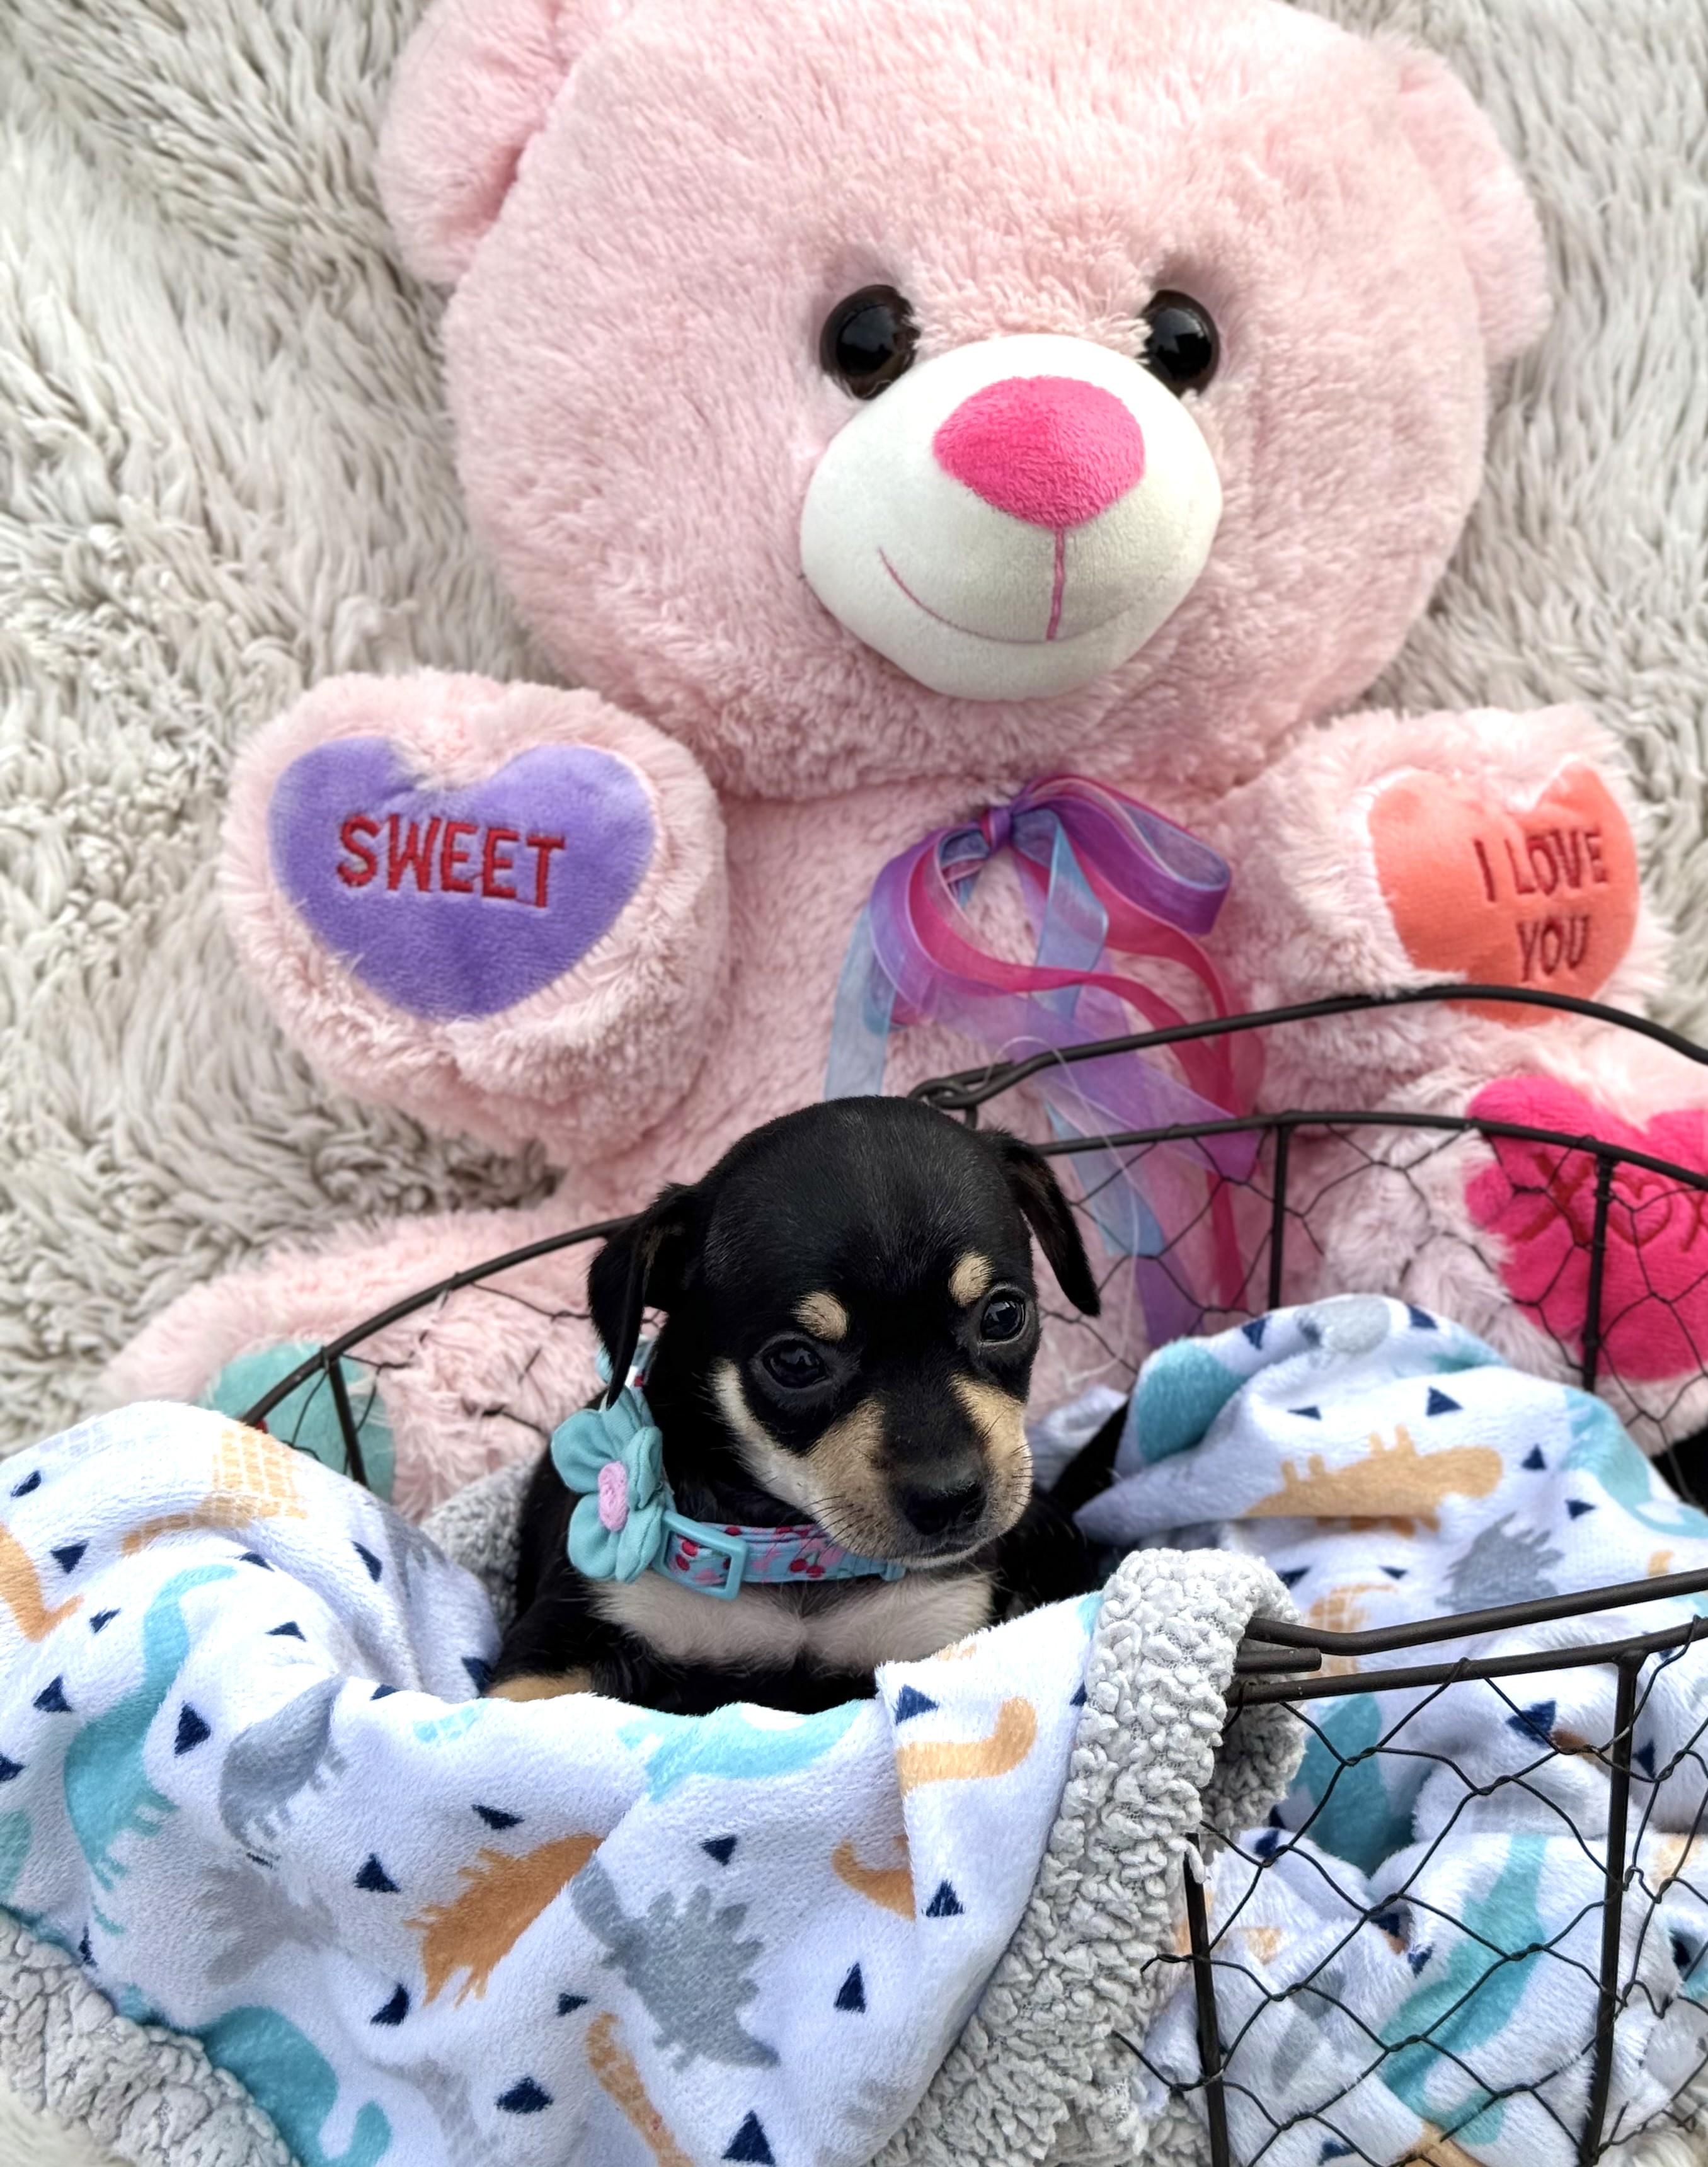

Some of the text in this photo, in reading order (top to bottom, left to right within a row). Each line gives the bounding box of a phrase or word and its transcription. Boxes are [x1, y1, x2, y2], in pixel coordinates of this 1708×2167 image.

[336, 814, 565, 908] SWEET
[1474, 828, 1608, 902] I LOVE
[1516, 914, 1590, 981] YOU
